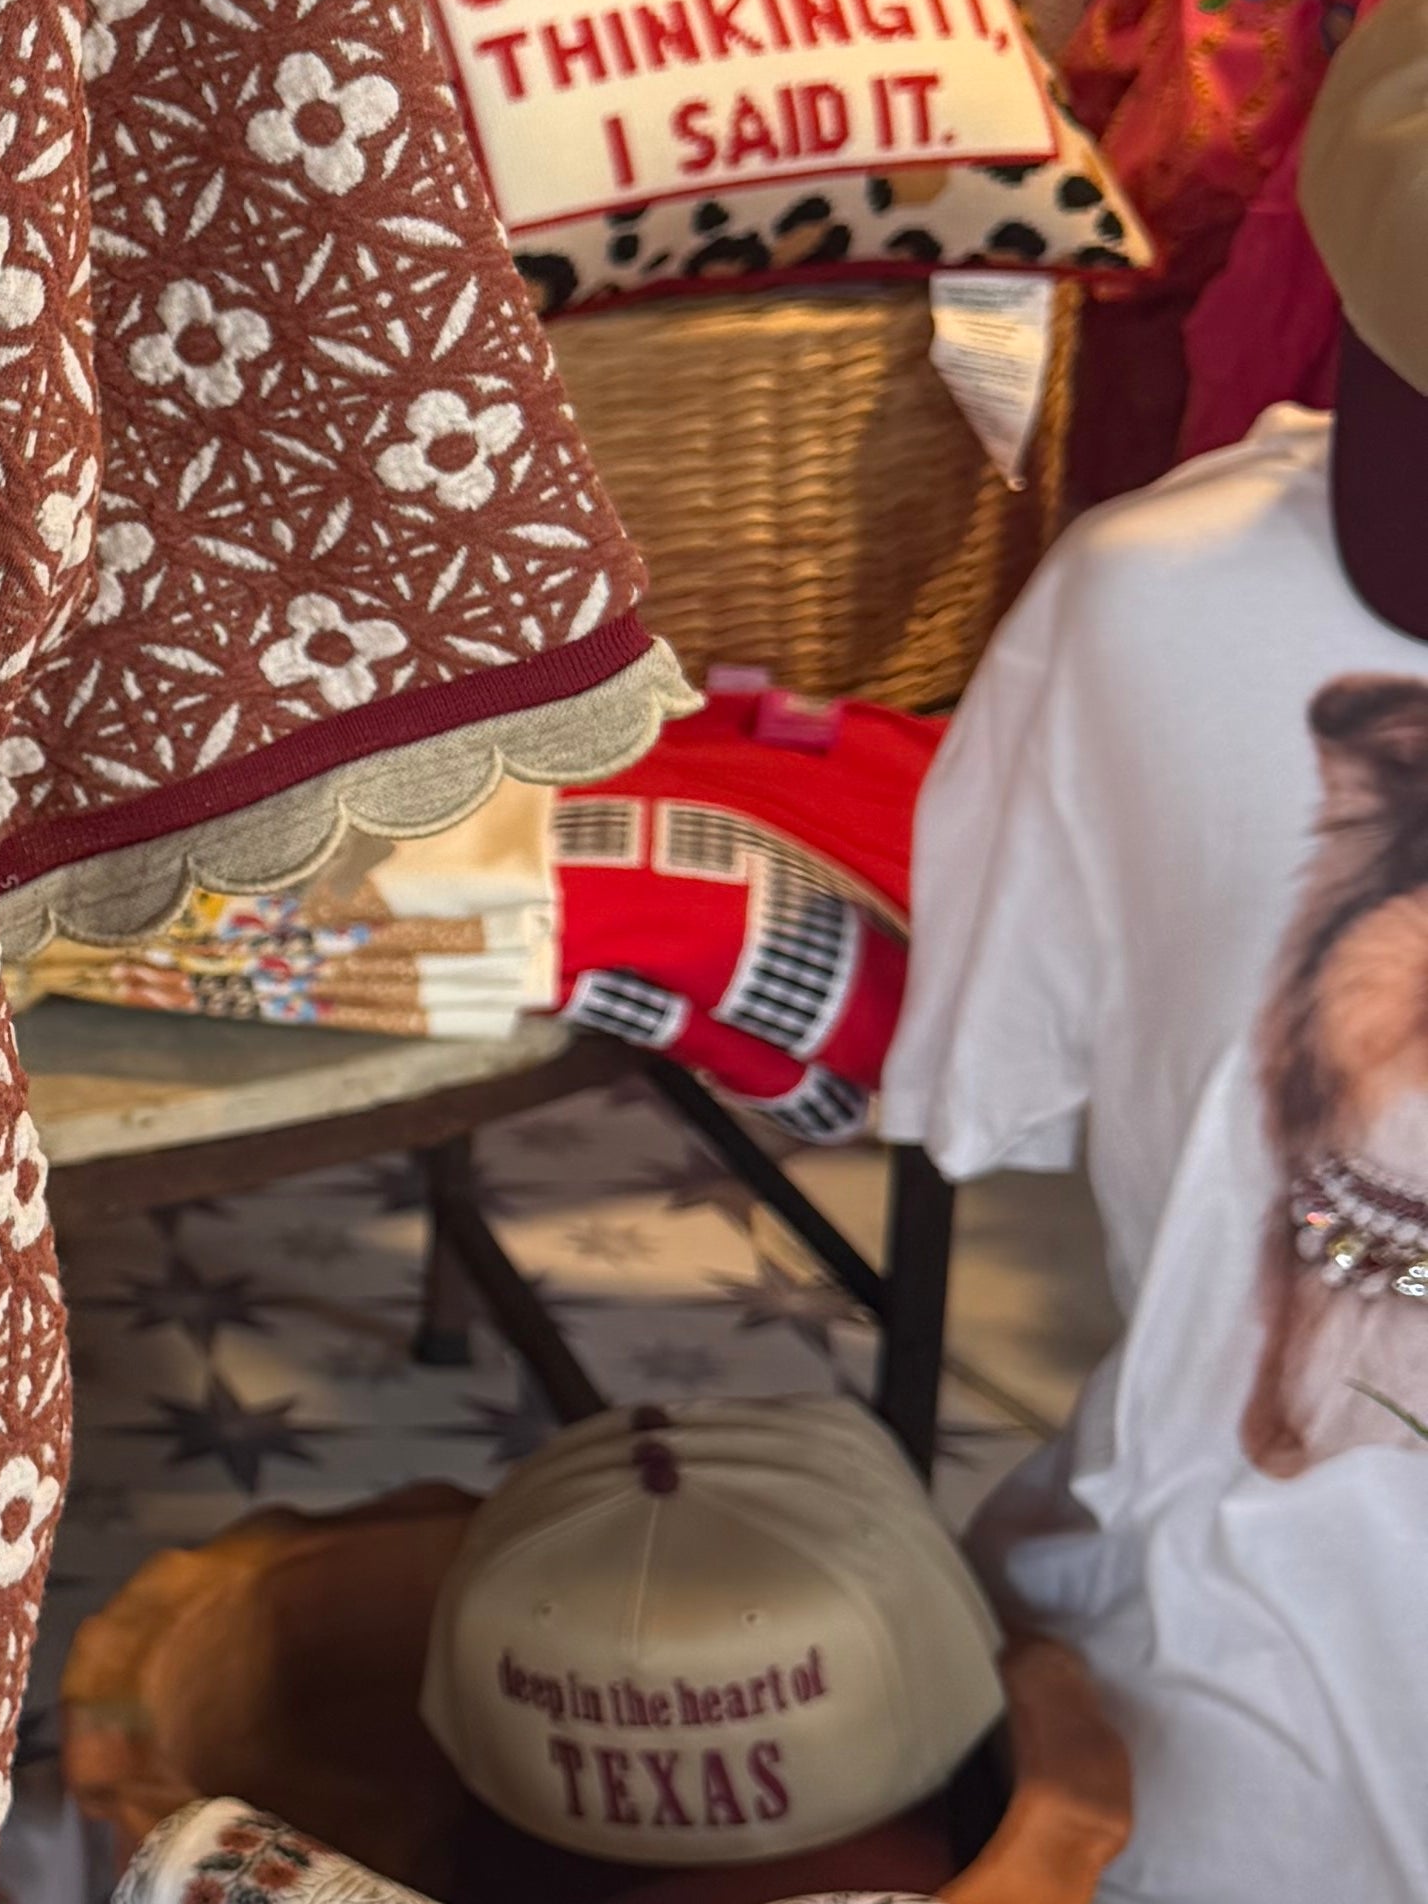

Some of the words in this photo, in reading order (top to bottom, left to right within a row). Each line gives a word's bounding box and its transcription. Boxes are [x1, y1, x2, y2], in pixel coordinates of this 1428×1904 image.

[604, 113, 634, 188] I
[670, 82, 852, 176] SAID
[869, 72, 956, 154] IT.
[566, 1669, 604, 1724] in
[608, 1675, 672, 1728] the
[673, 1665, 789, 1728] heart
[790, 1644, 827, 1709] of
[546, 1733, 790, 1828] TEXAS
